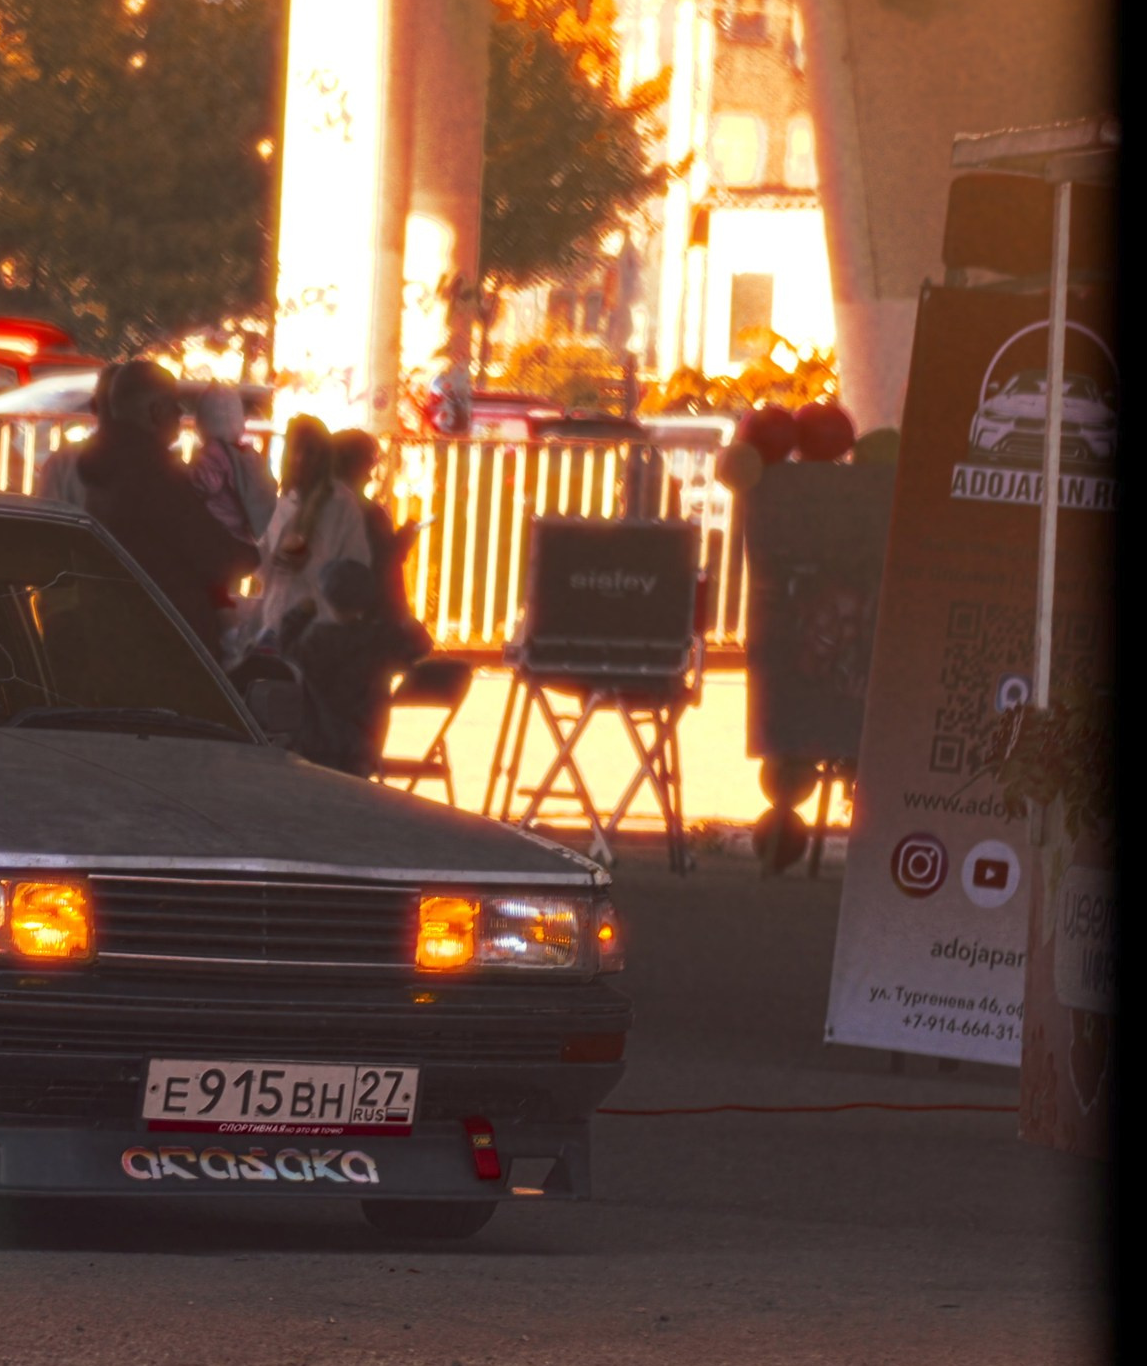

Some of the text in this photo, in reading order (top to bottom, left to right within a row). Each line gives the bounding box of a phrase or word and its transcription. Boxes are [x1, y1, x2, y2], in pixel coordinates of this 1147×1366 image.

[869, 986, 891, 1002] ул.
[895, 985, 975, 1009] Тургенева
[978, 995, 1001, 1016] 46,
[358, 1070, 404, 1107] 27
[353, 1108, 385, 1122] RUS
[218, 1122, 287, 1134] СПОРТИВНАЯ
